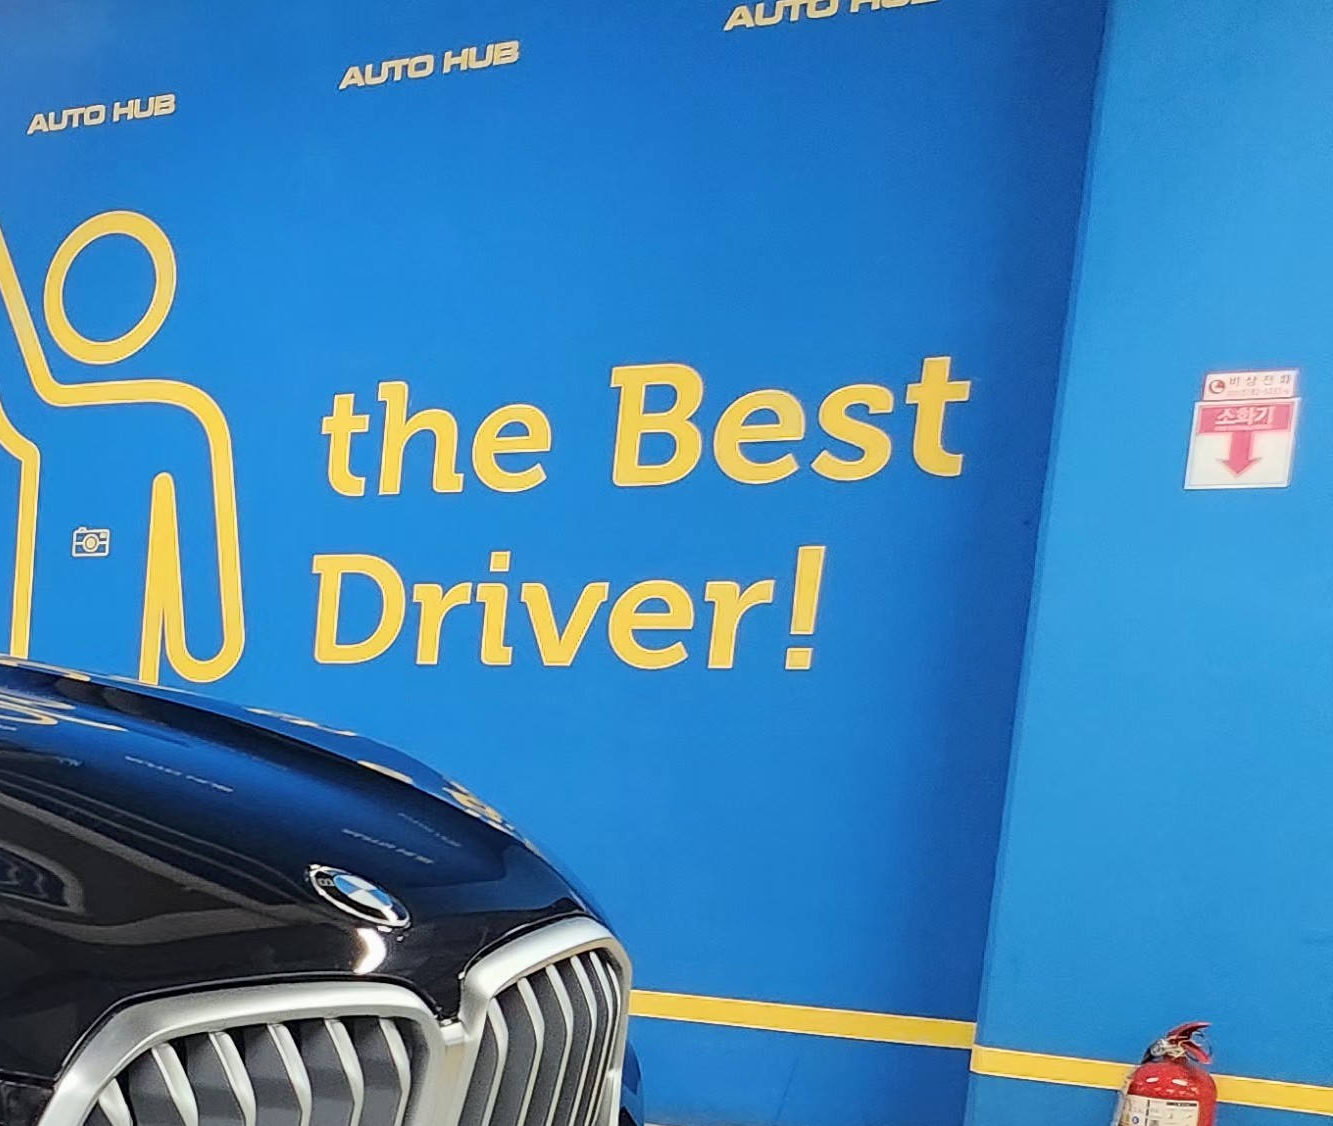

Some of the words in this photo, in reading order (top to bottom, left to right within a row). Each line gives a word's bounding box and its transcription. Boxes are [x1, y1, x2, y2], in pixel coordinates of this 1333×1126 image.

[723, 0, 840, 31] AUTO
[338, 54, 434, 90] AUTO
[442, 39, 520, 74] HUB
[27, 103, 106, 135] AUTO
[112, 93, 176, 122] HUB
[320, 380, 552, 497] the
[610, 356, 972, 488] Best
[1215, 406, 1275, 425] 소화기
[311, 545, 826, 671] Driver!
